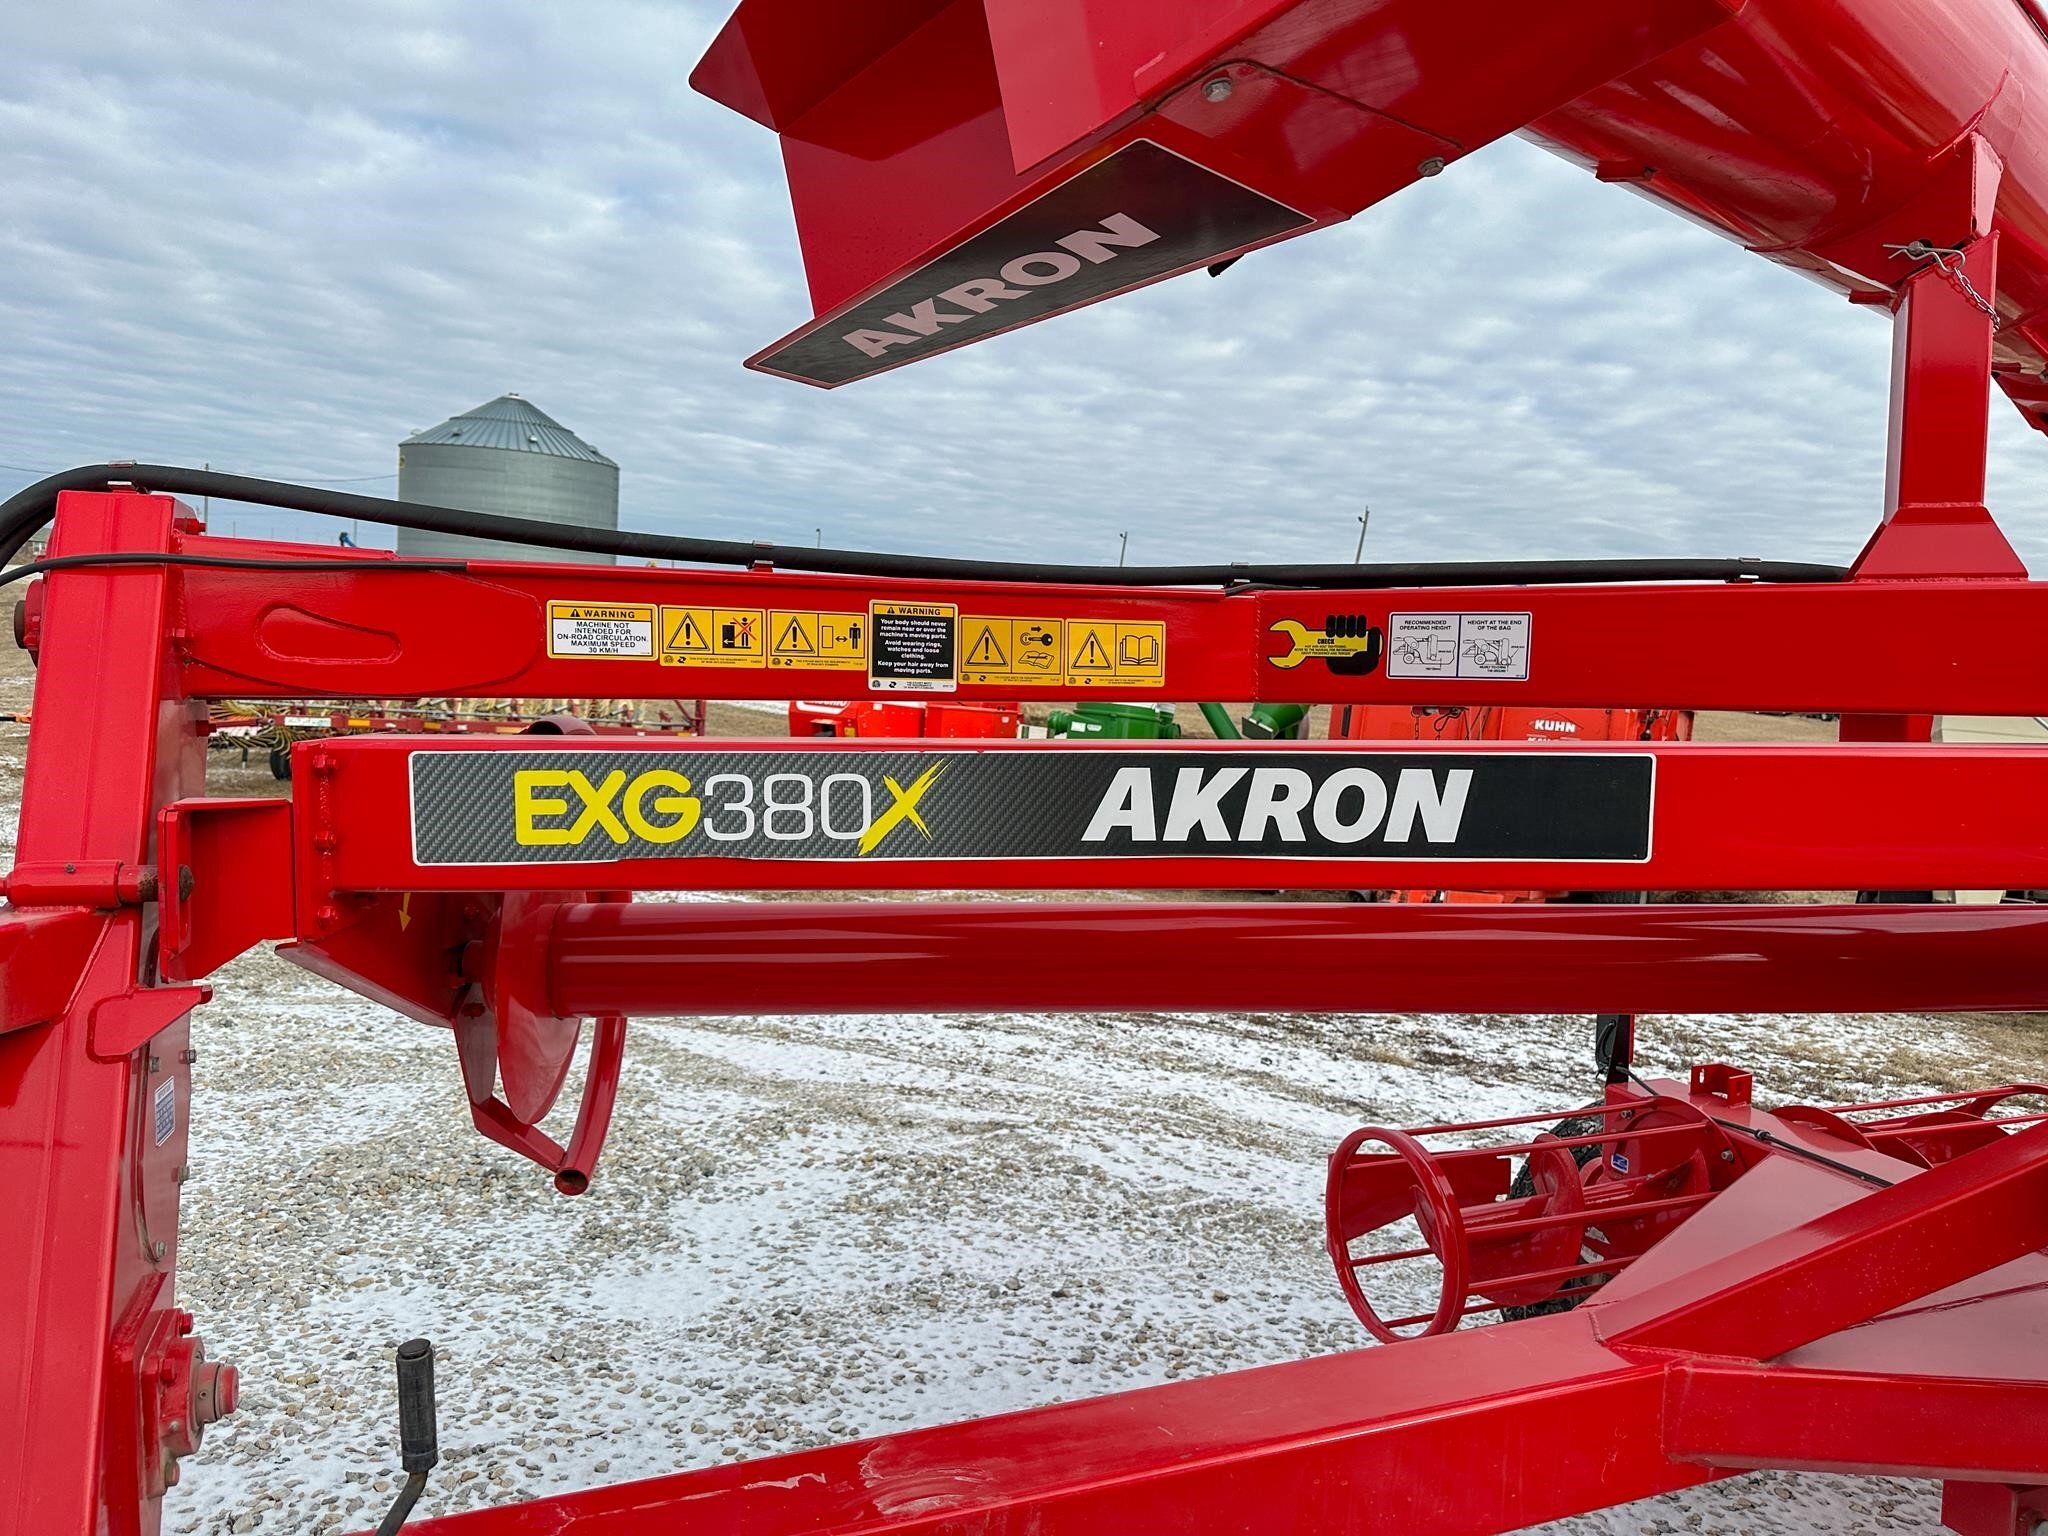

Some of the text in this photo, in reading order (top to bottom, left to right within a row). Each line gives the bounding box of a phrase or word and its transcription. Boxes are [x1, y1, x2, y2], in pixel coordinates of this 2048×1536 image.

[842, 212, 1161, 358] AKRON
[584, 610, 635, 618] WARNING
[899, 607, 940, 616] WARNING
[1534, 719, 1576, 733] KUHN
[1080, 767, 1474, 844] AKRON
